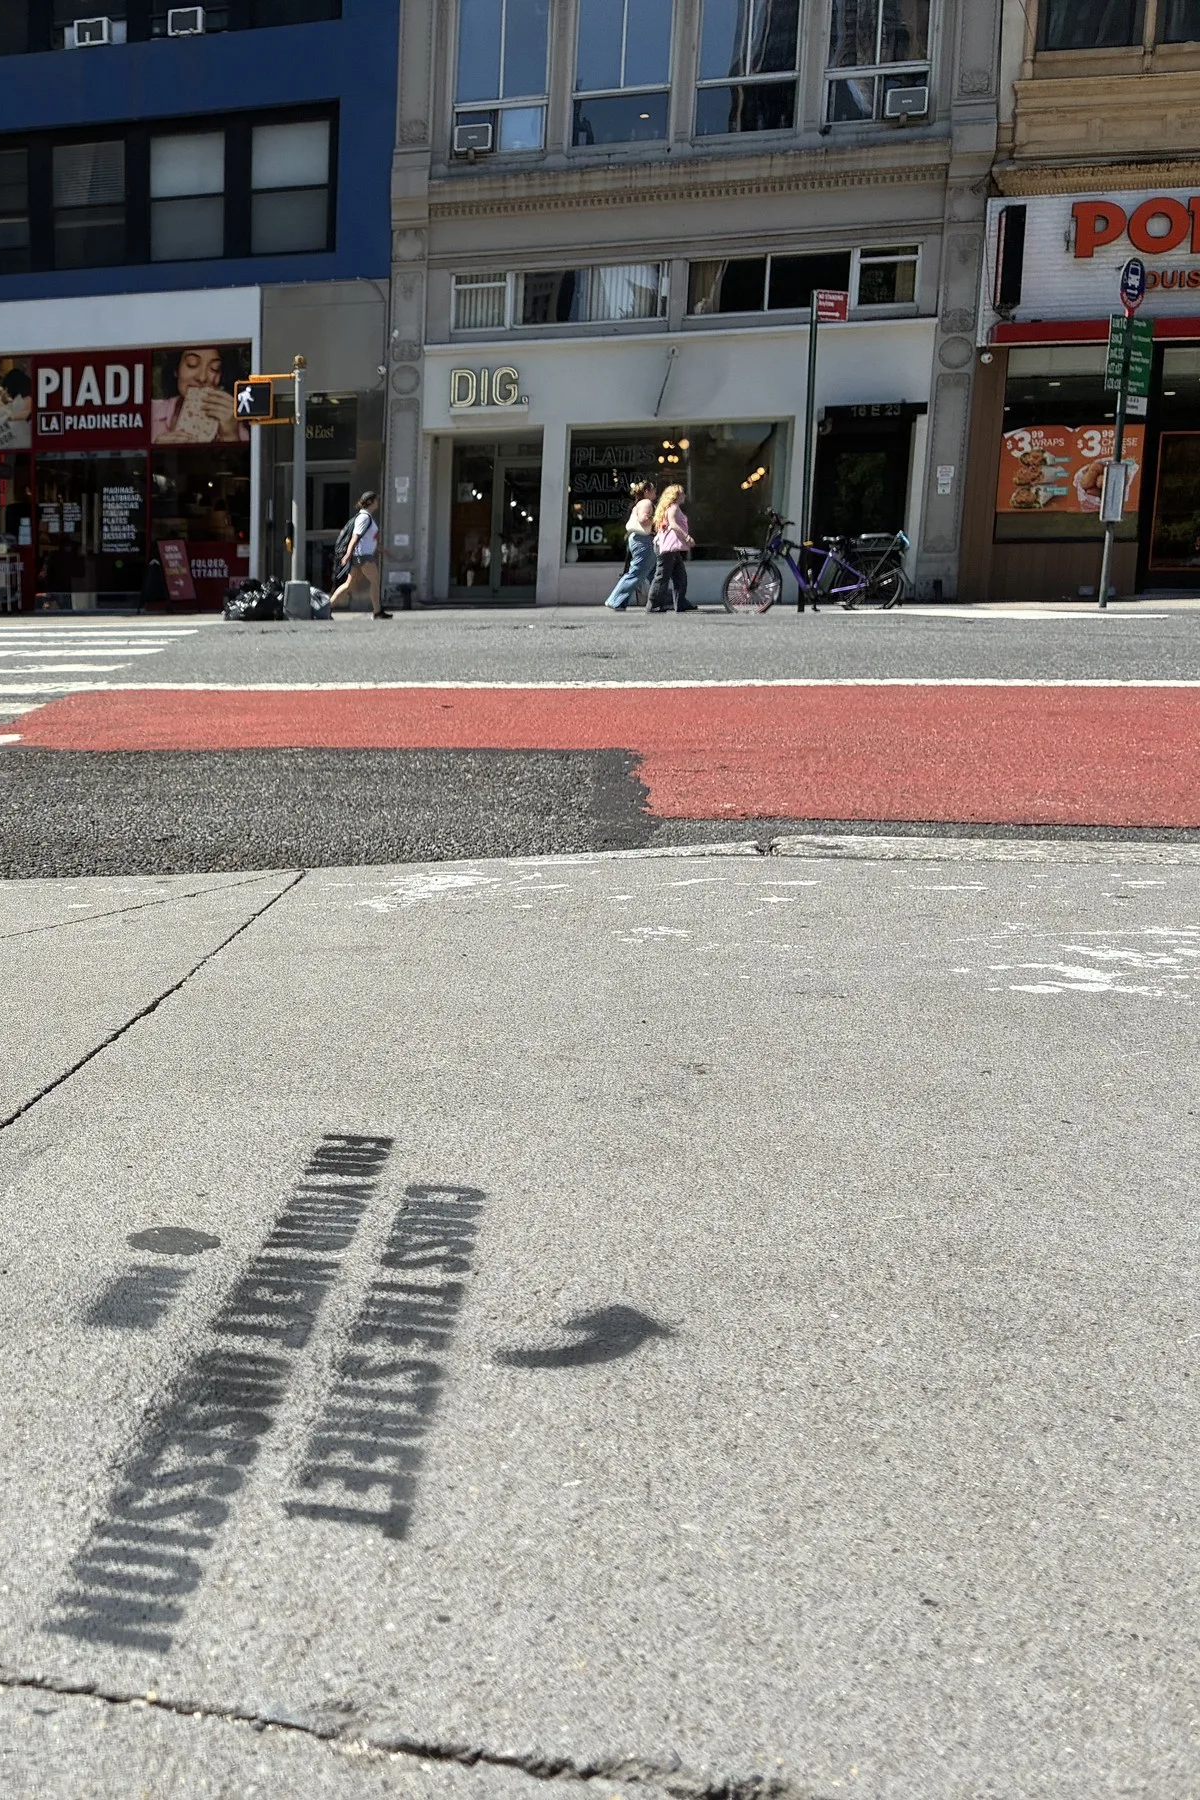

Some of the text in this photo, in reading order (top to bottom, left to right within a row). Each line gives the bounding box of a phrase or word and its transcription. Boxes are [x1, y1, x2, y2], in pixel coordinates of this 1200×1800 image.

[1145, 270, 1200, 289] OUIS
[37, 363, 144, 408] PIADI
[451, 366, 529, 407] DIG.
[41, 413, 143, 431] LA PIADINERIA
[315, 425, 335, 439] East
[1031, 438, 1065, 447] WRAPS
[1101, 437, 1138, 447] CHESE
[1101, 446, 1126, 455] BITS
[575, 446, 656, 467] PLATES
[571, 526, 607, 544] DIG.
[303, 1132, 394, 1177] FOR
[261, 1183, 378, 1253] YOUR
[210, 1255, 343, 1350] NEXT
[282, 1184, 488, 1541] CROSS THE STREET
[41, 1350, 291, 1652] OBSESSION
